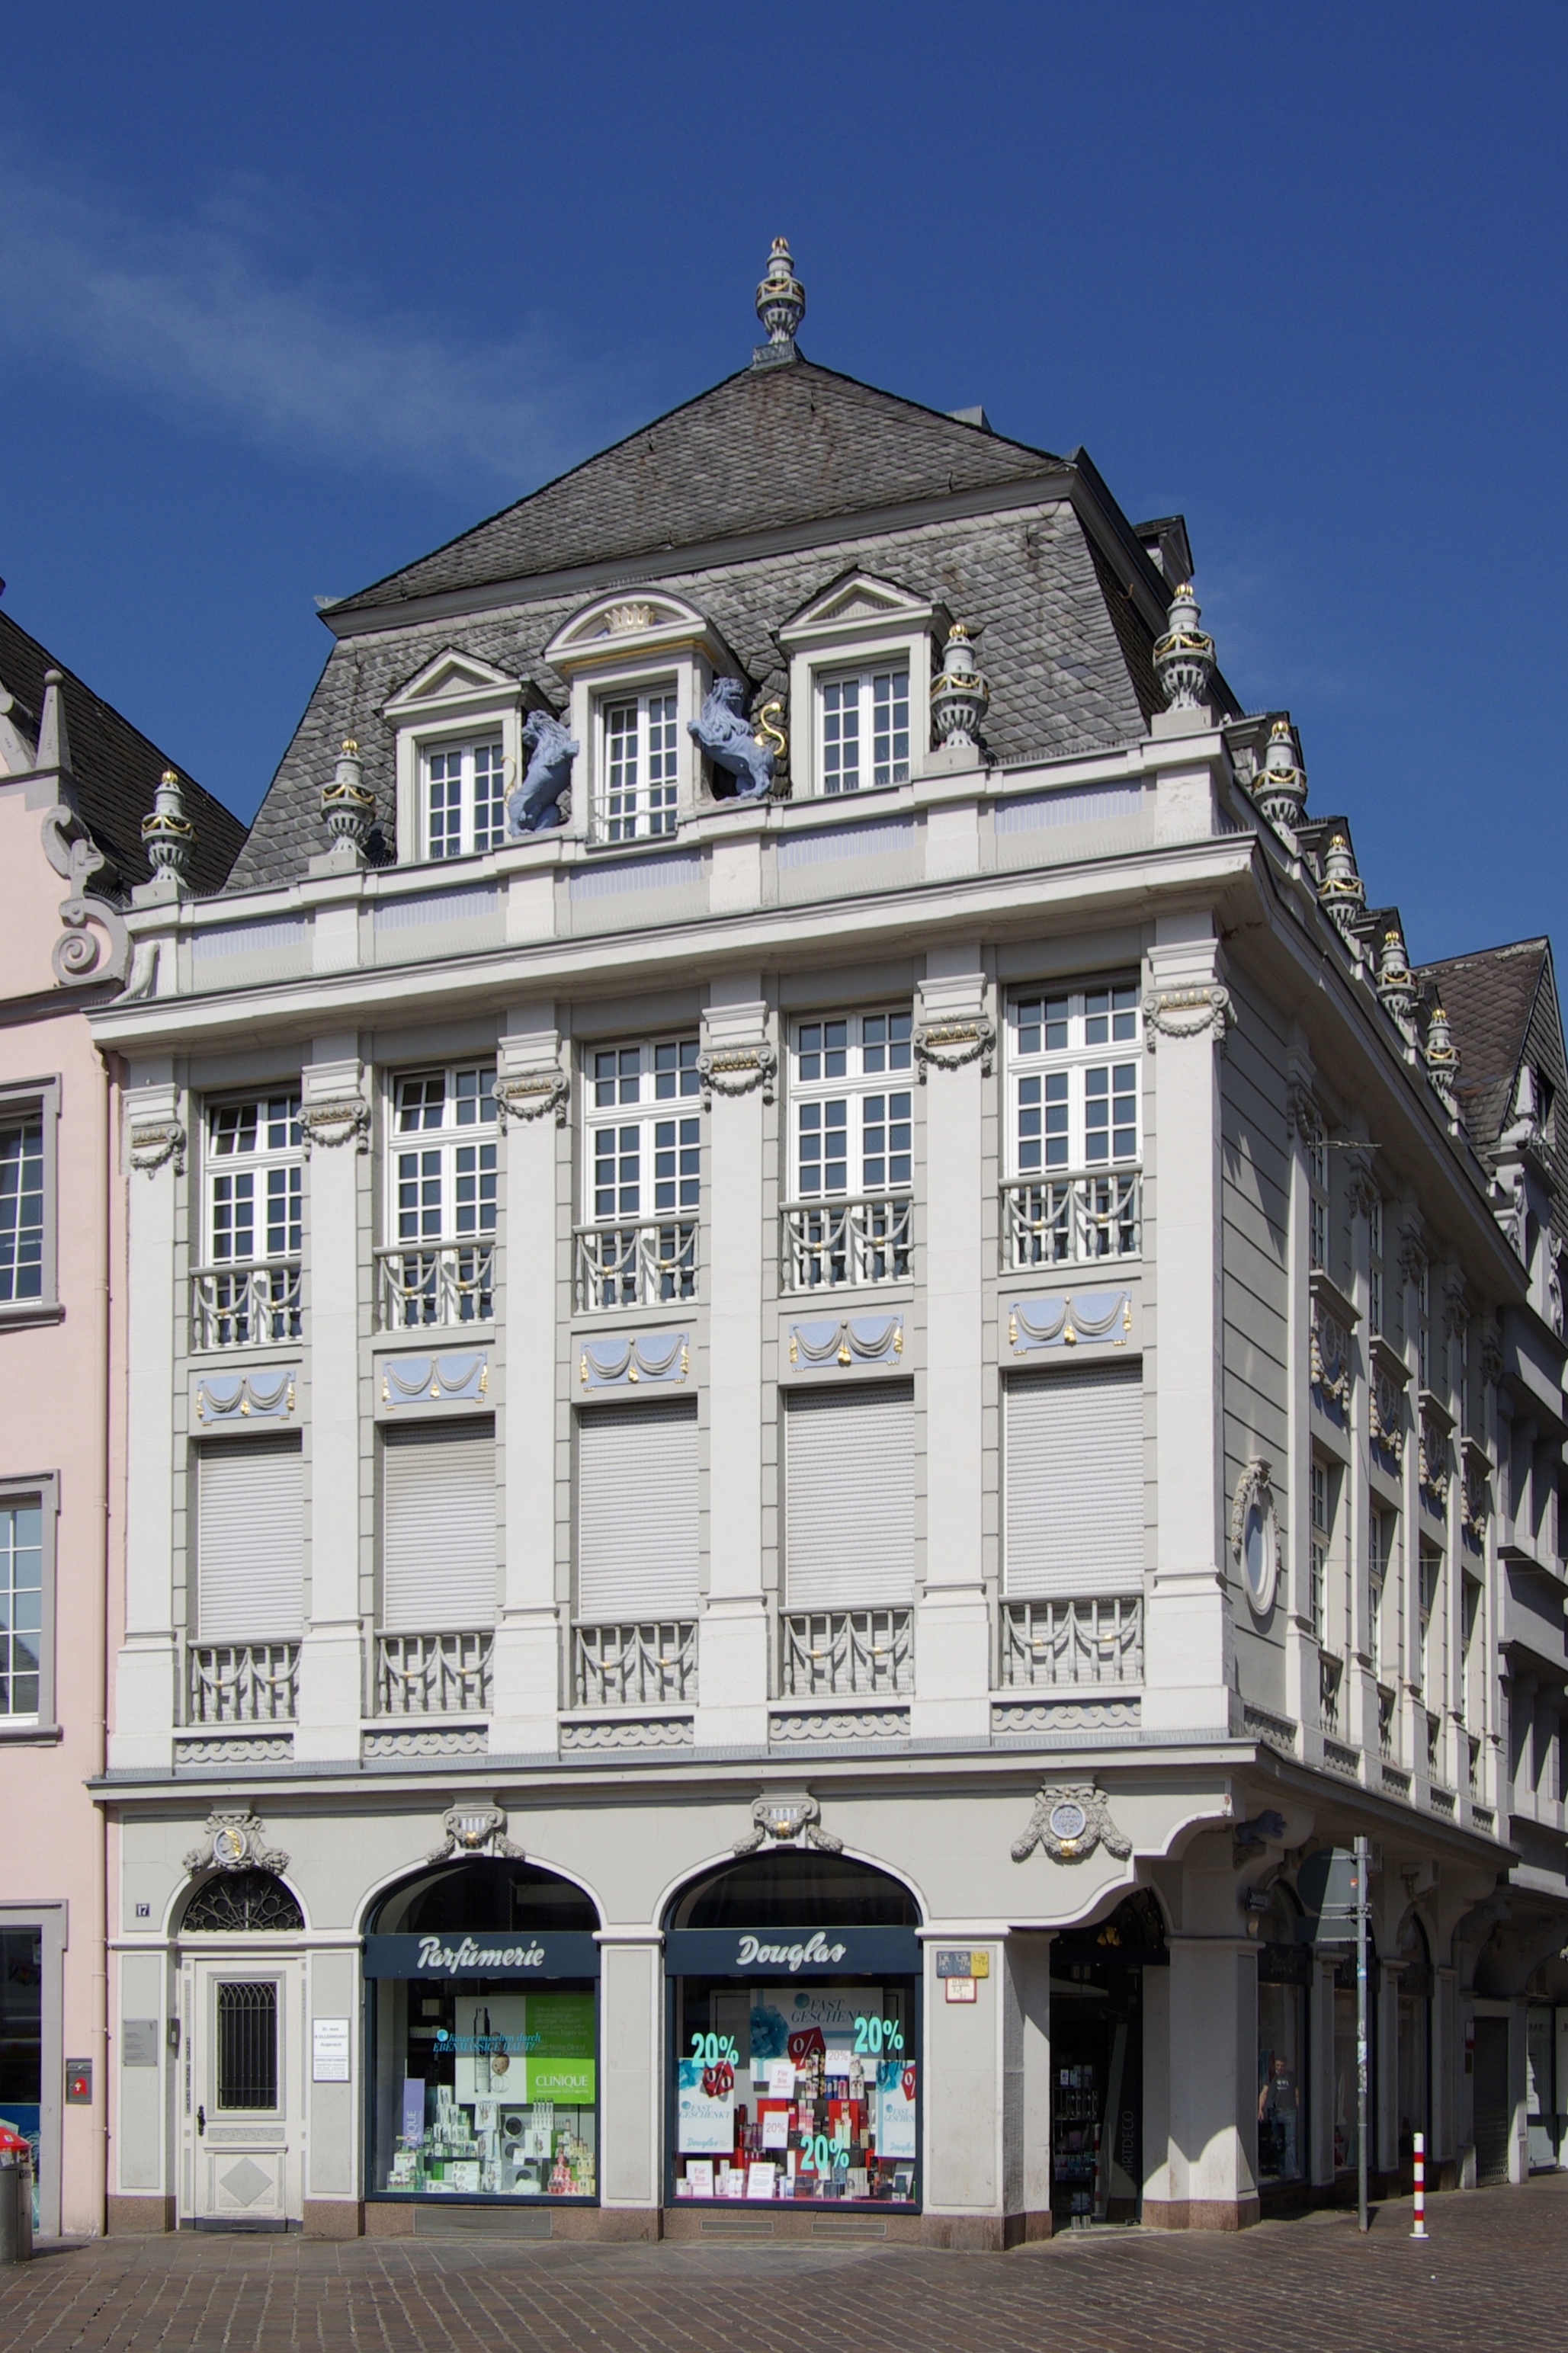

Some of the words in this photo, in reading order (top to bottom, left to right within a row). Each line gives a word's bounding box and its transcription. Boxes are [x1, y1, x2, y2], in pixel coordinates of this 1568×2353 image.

[138, 1905, 147, 1915] 17
[417, 1936, 545, 1973] Parfümerie
[736, 1931, 846, 1972] Douglas
[811, 1999, 845, 2011] FAST
[476, 2032, 514, 2042] aussehen
[517, 2032, 541, 2042] durch
[854, 2016, 904, 2053] 20%
[691, 2032, 739, 2069] 20%
[828, 2050, 848, 2061] 20%
[535, 2076, 588, 2089] CLINIQUE
[679, 2111, 731, 2119] GESCHENKT
[893, 2108, 909, 2116] FAST
[765, 2123, 786, 2133] 20%
[686, 2137, 719, 2149] Douglas
[1121, 2110, 1134, 2173] ARTDECO
[800, 2133, 850, 2171] 20%
